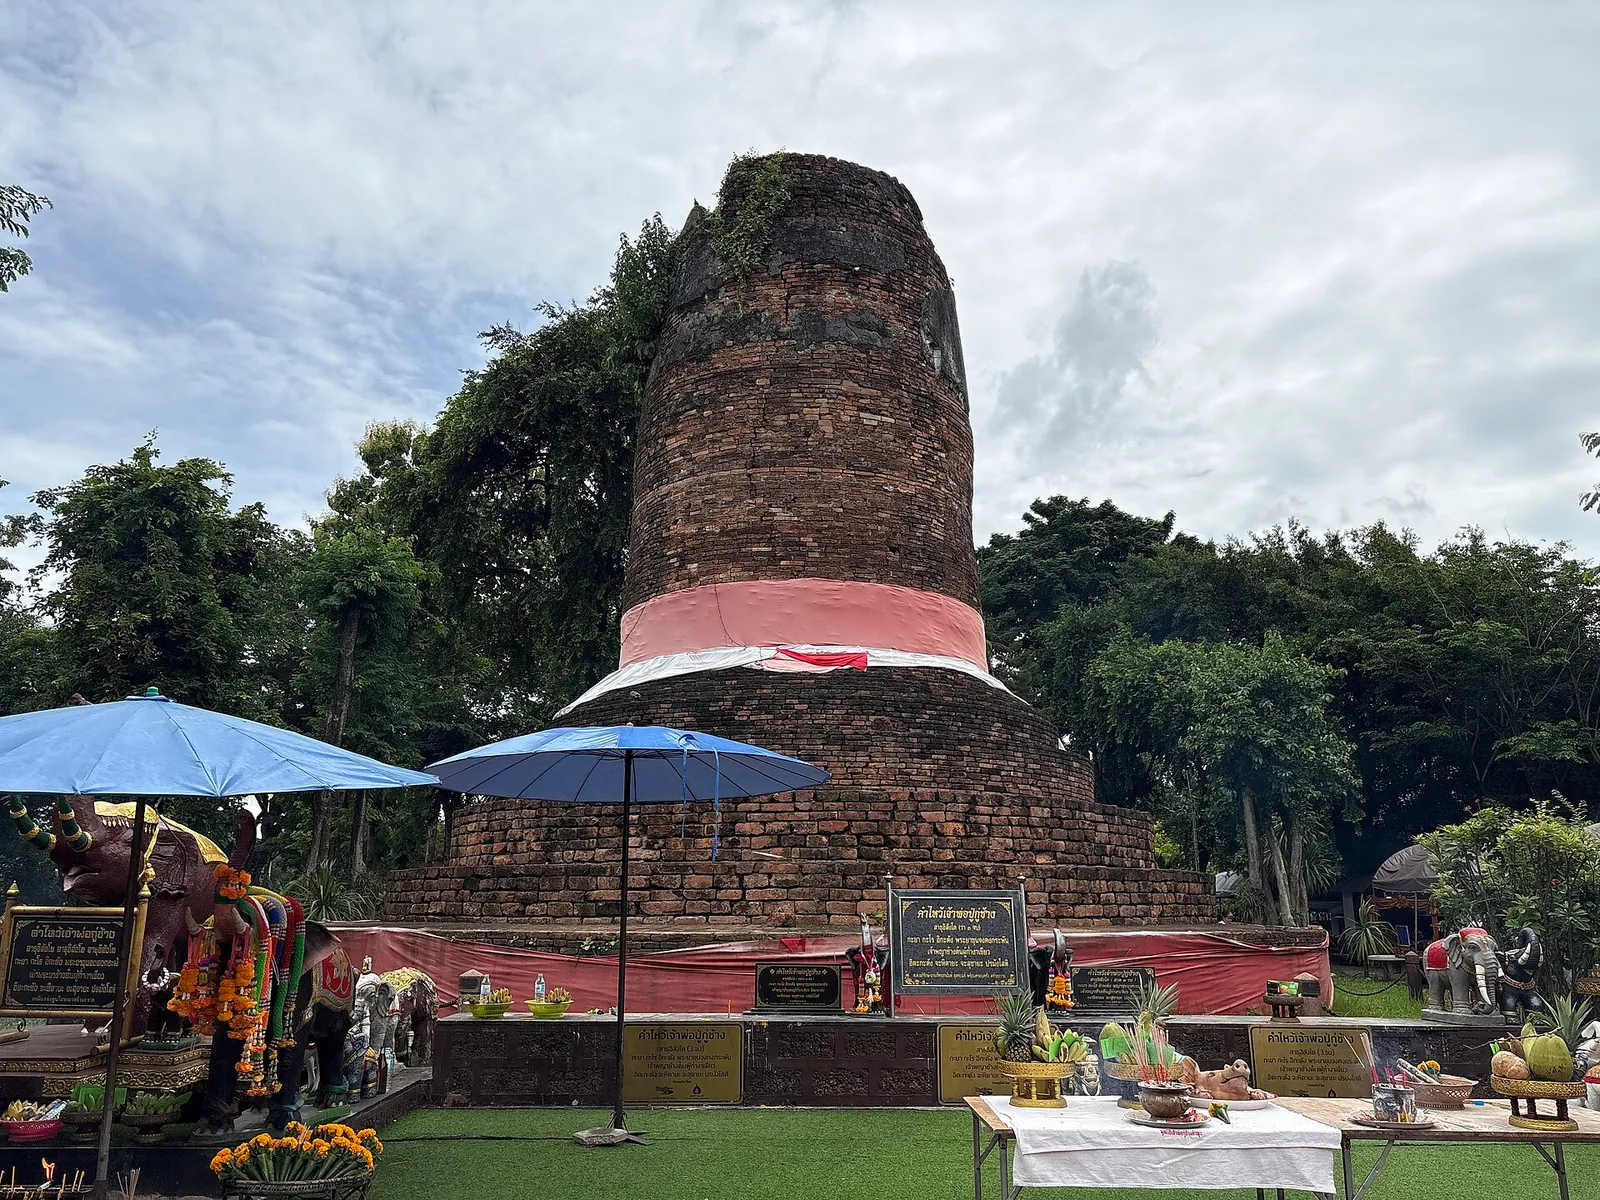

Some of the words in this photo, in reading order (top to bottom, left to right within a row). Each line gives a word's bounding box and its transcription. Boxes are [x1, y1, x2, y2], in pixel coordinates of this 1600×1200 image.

[917, 905, 996, 922] คำไหว้เจ้าพ่อปู่กู่ช้าง
[30, 925, 116, 942] คำไหว้เจ้าพ่อกู่ช้าง
[638, 1028, 726, 1044] คำไหว้เจ้าพ่อปู่กู่ช้าง
